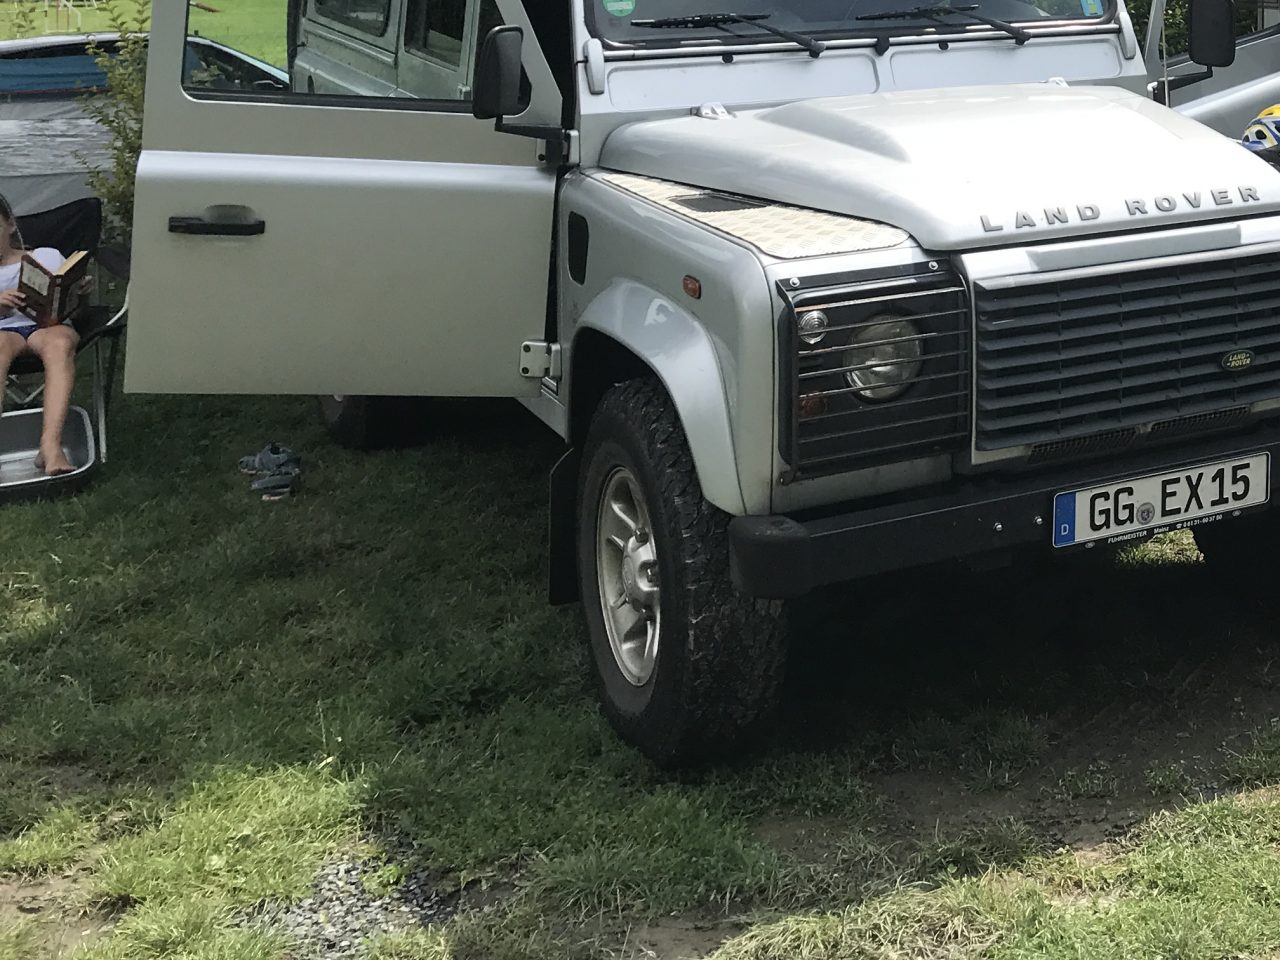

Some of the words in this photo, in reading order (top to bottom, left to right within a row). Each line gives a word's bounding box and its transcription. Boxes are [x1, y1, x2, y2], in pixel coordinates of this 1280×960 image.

[979, 203, 1101, 233] LAND
[1124, 185, 1260, 216] ROVER
[1229, 353, 1246, 361] LAND
[1230, 358, 1250, 367] ROVER
[1089, 486, 1135, 532] GG
[1060, 524, 1069, 536] D
[1153, 525, 1170, 535] Mainz
